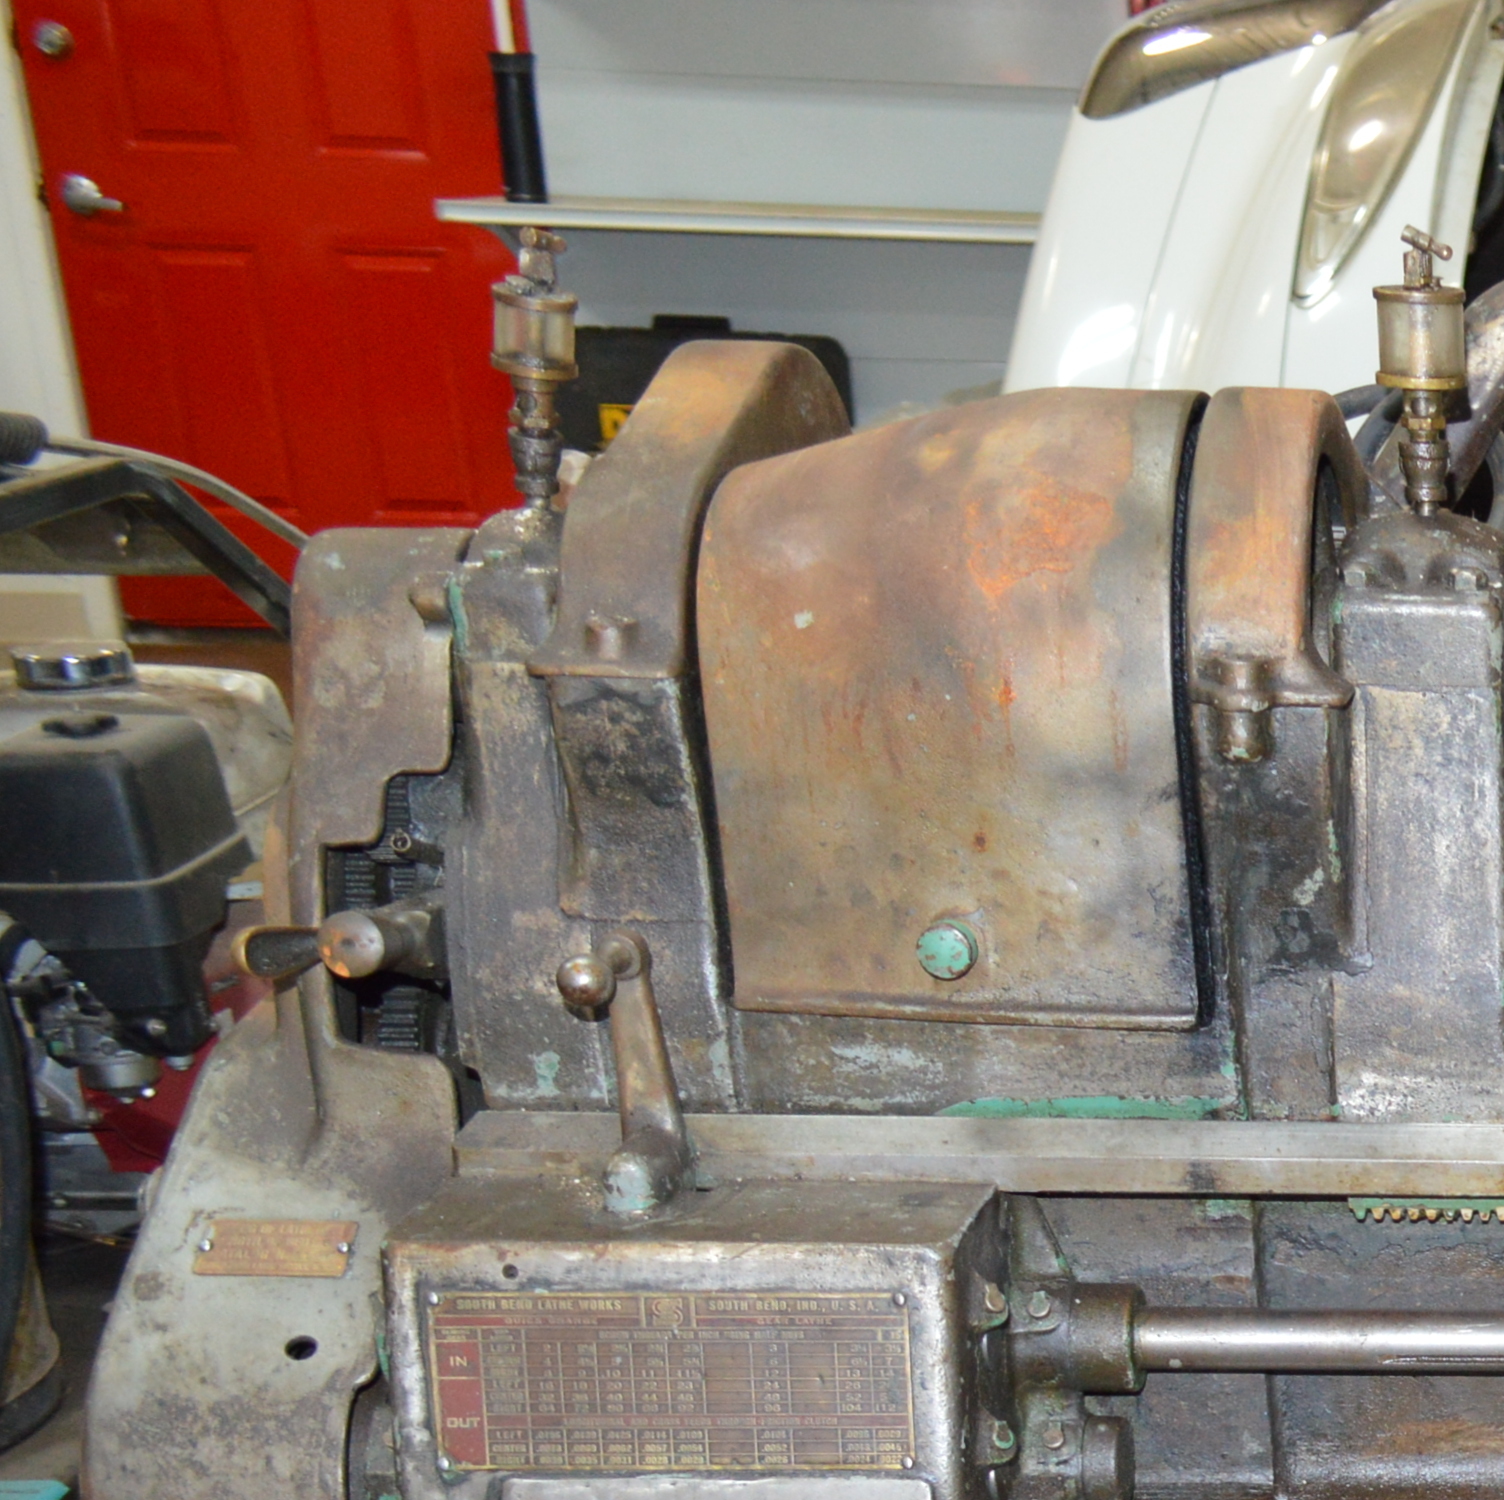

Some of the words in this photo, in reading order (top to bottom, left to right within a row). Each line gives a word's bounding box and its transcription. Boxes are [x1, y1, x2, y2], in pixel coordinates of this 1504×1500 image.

[456, 1299, 496, 1311] SOUTH
[501, 1299, 533, 1311] BEND
[538, 1300, 574, 1311] LATHE
[578, 1300, 622, 1311] WORKS
[709, 1300, 748, 1311] SOUTH
[755, 1300, 792, 1313] BEND,
[831, 1301, 844, 1311] U.
[850, 1301, 861, 1311] S.
[449, 1356, 468, 1367] IN
[641, 1369, 655, 1378] 11
[764, 1369, 779, 1378] 12
[845, 1369, 861, 1378] 13
[844, 1381, 861, 1390] 26
[841, 1404, 862, 1412] 104
[875, 1404, 897, 1412] 112
[446, 1416, 481, 1428] OUT
[495, 1430, 522, 1439] LEFT
[492, 1443, 527, 1452] CENTER
